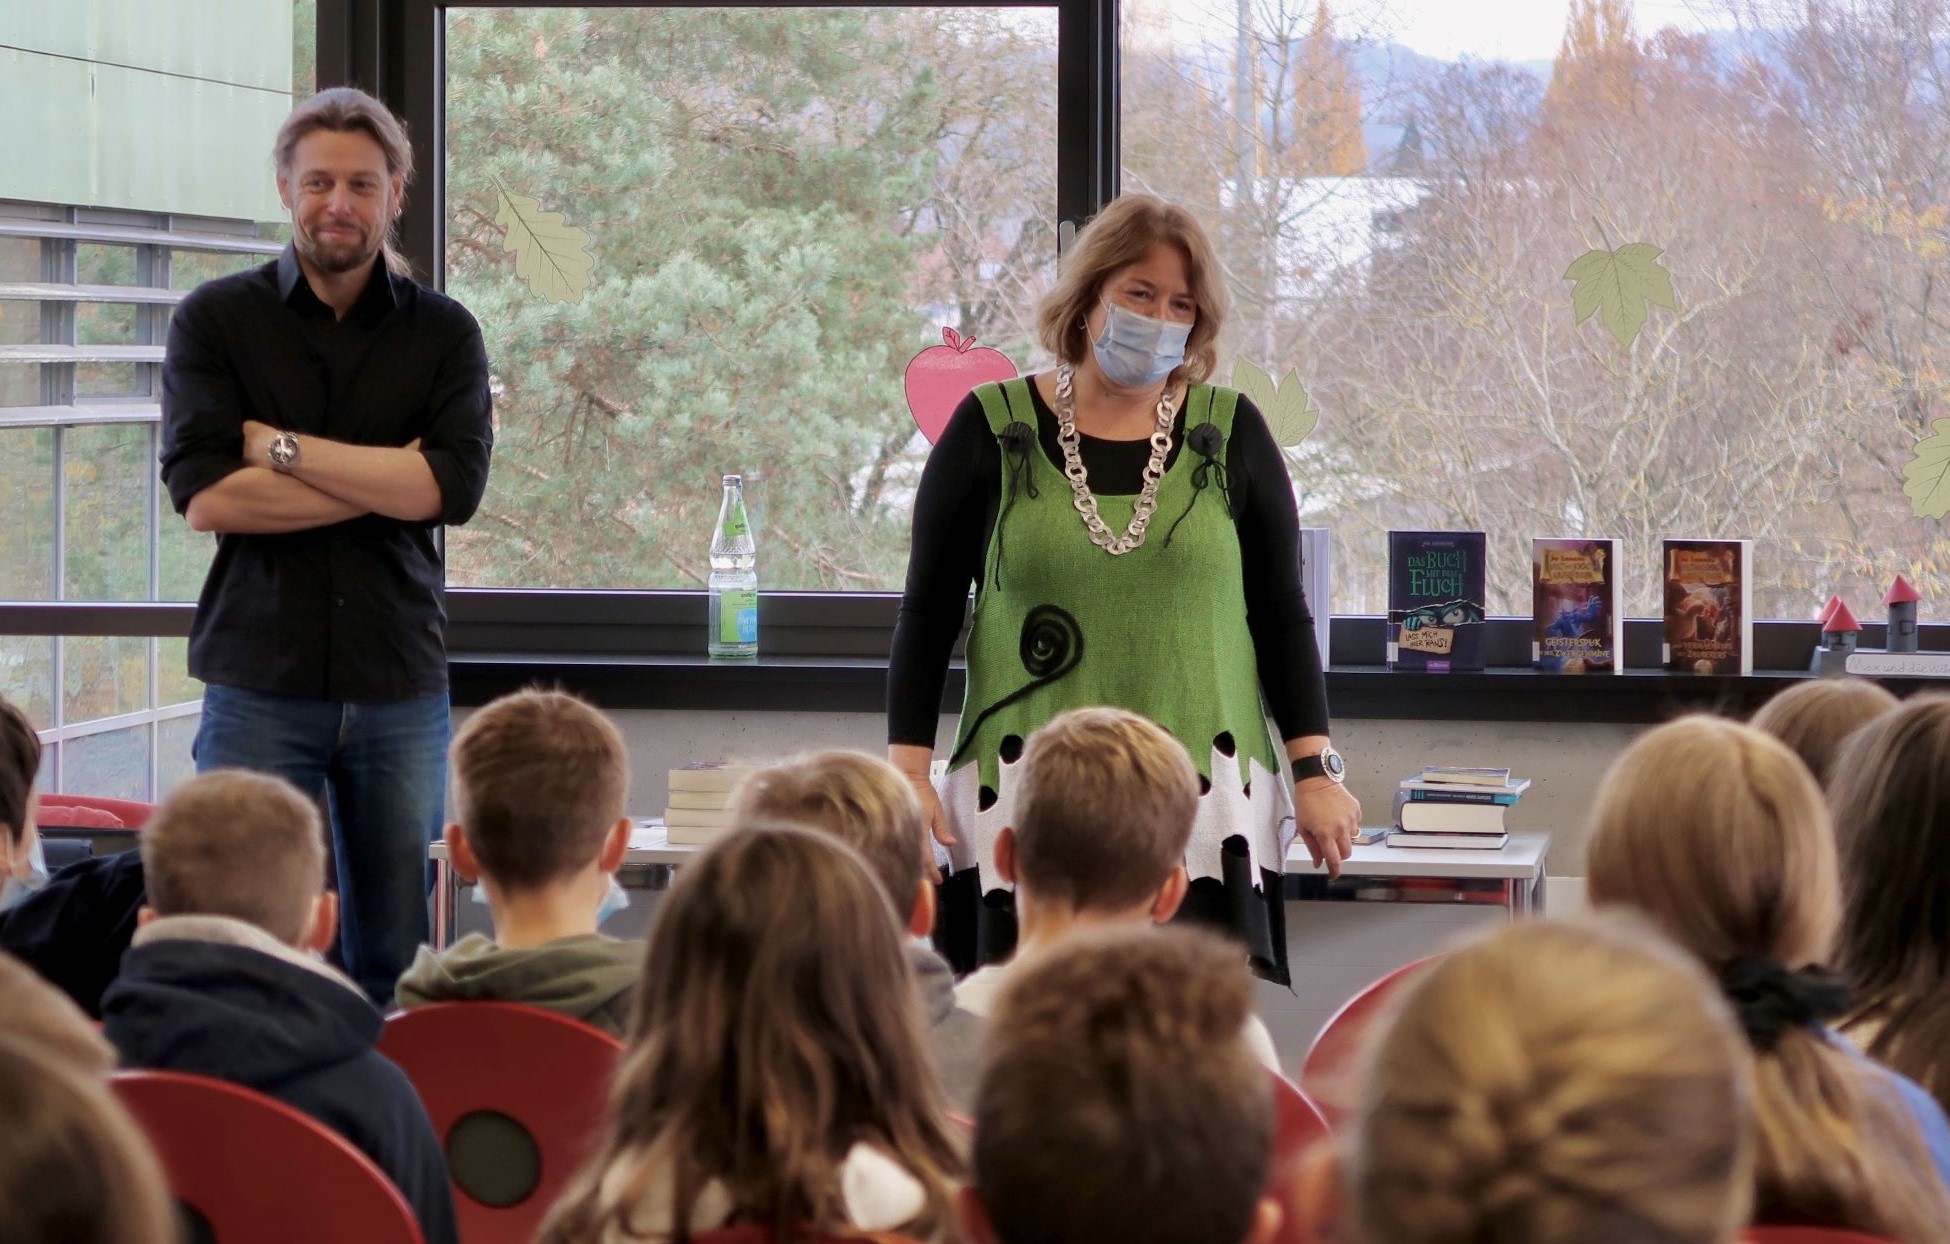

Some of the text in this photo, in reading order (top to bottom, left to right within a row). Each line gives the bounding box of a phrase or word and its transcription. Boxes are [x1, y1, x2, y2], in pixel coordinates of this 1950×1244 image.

[1408, 551, 1467, 573] DAS BUCH
[1409, 569, 1464, 597] FLUCH
[1405, 630, 1438, 642] LASS MICH
[1409, 637, 1448, 649] HIER RAUS!
[1545, 638, 1602, 648] GEISTERSPUK
